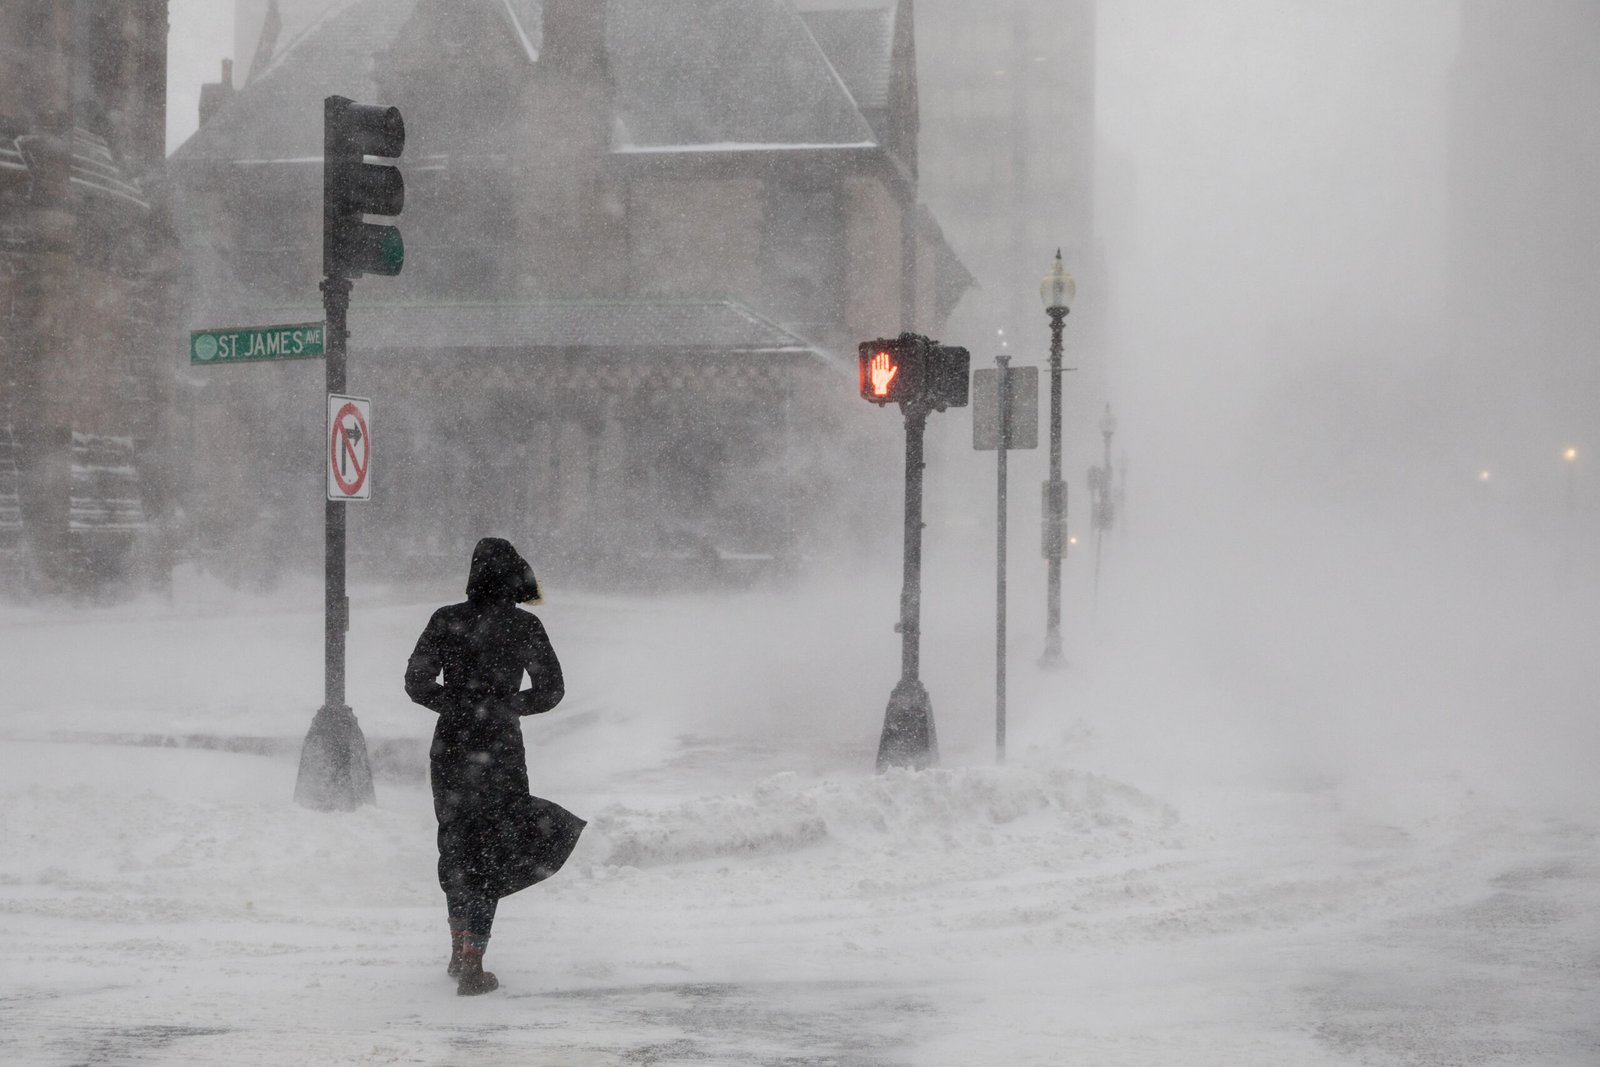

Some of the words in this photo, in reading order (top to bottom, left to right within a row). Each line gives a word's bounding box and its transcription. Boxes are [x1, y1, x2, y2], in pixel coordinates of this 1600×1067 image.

[219, 335, 238, 357] ST
[244, 331, 304, 356] JAMES
[305, 330, 320, 344] AVE
